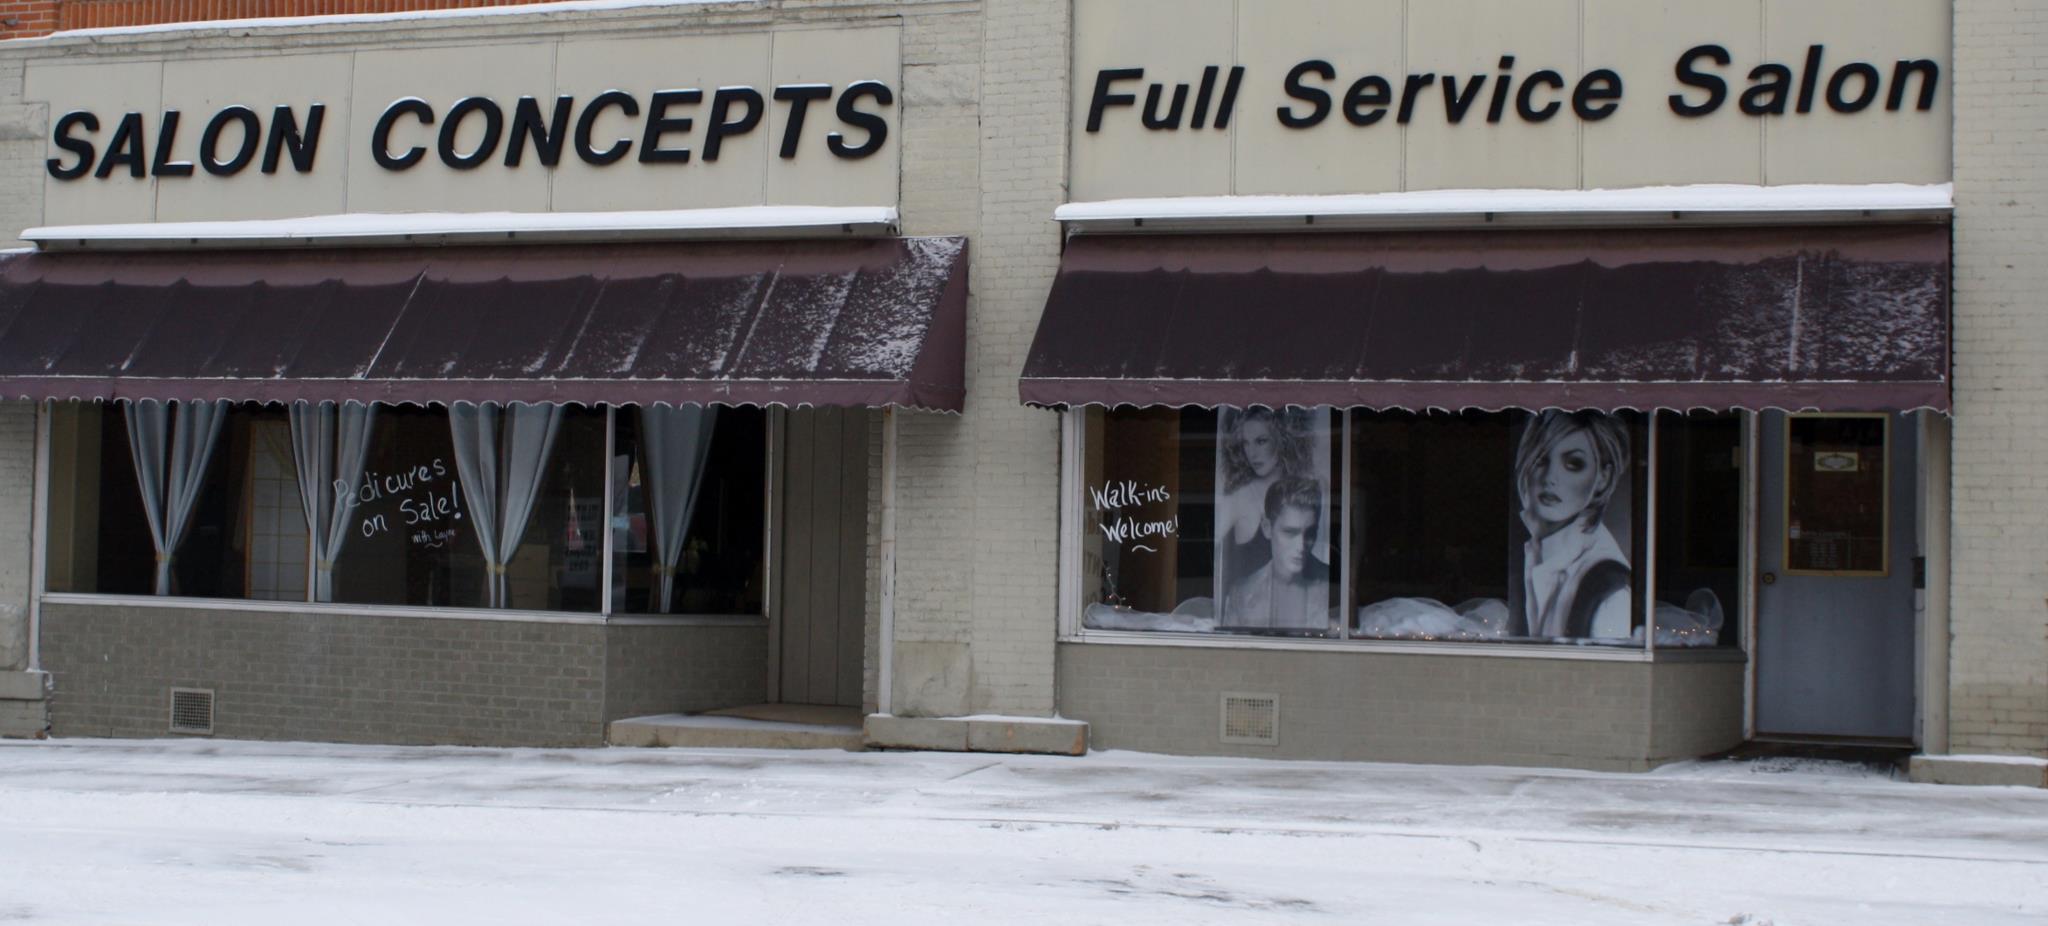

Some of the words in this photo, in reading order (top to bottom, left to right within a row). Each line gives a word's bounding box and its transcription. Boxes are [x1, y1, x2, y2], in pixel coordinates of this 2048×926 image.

[1086, 66, 1244, 133] Full
[1276, 55, 1623, 129] Service
[1668, 44, 1940, 118] Salon
[46, 103, 325, 181] SALON
[372, 80, 894, 171] CONCEPTS
[333, 458, 446, 512] Pedicures
[362, 513, 388, 538] on
[399, 480, 462, 525] Sale!
[1089, 479, 1171, 511] Walk-ins
[1099, 514, 1180, 544] Welcome!
